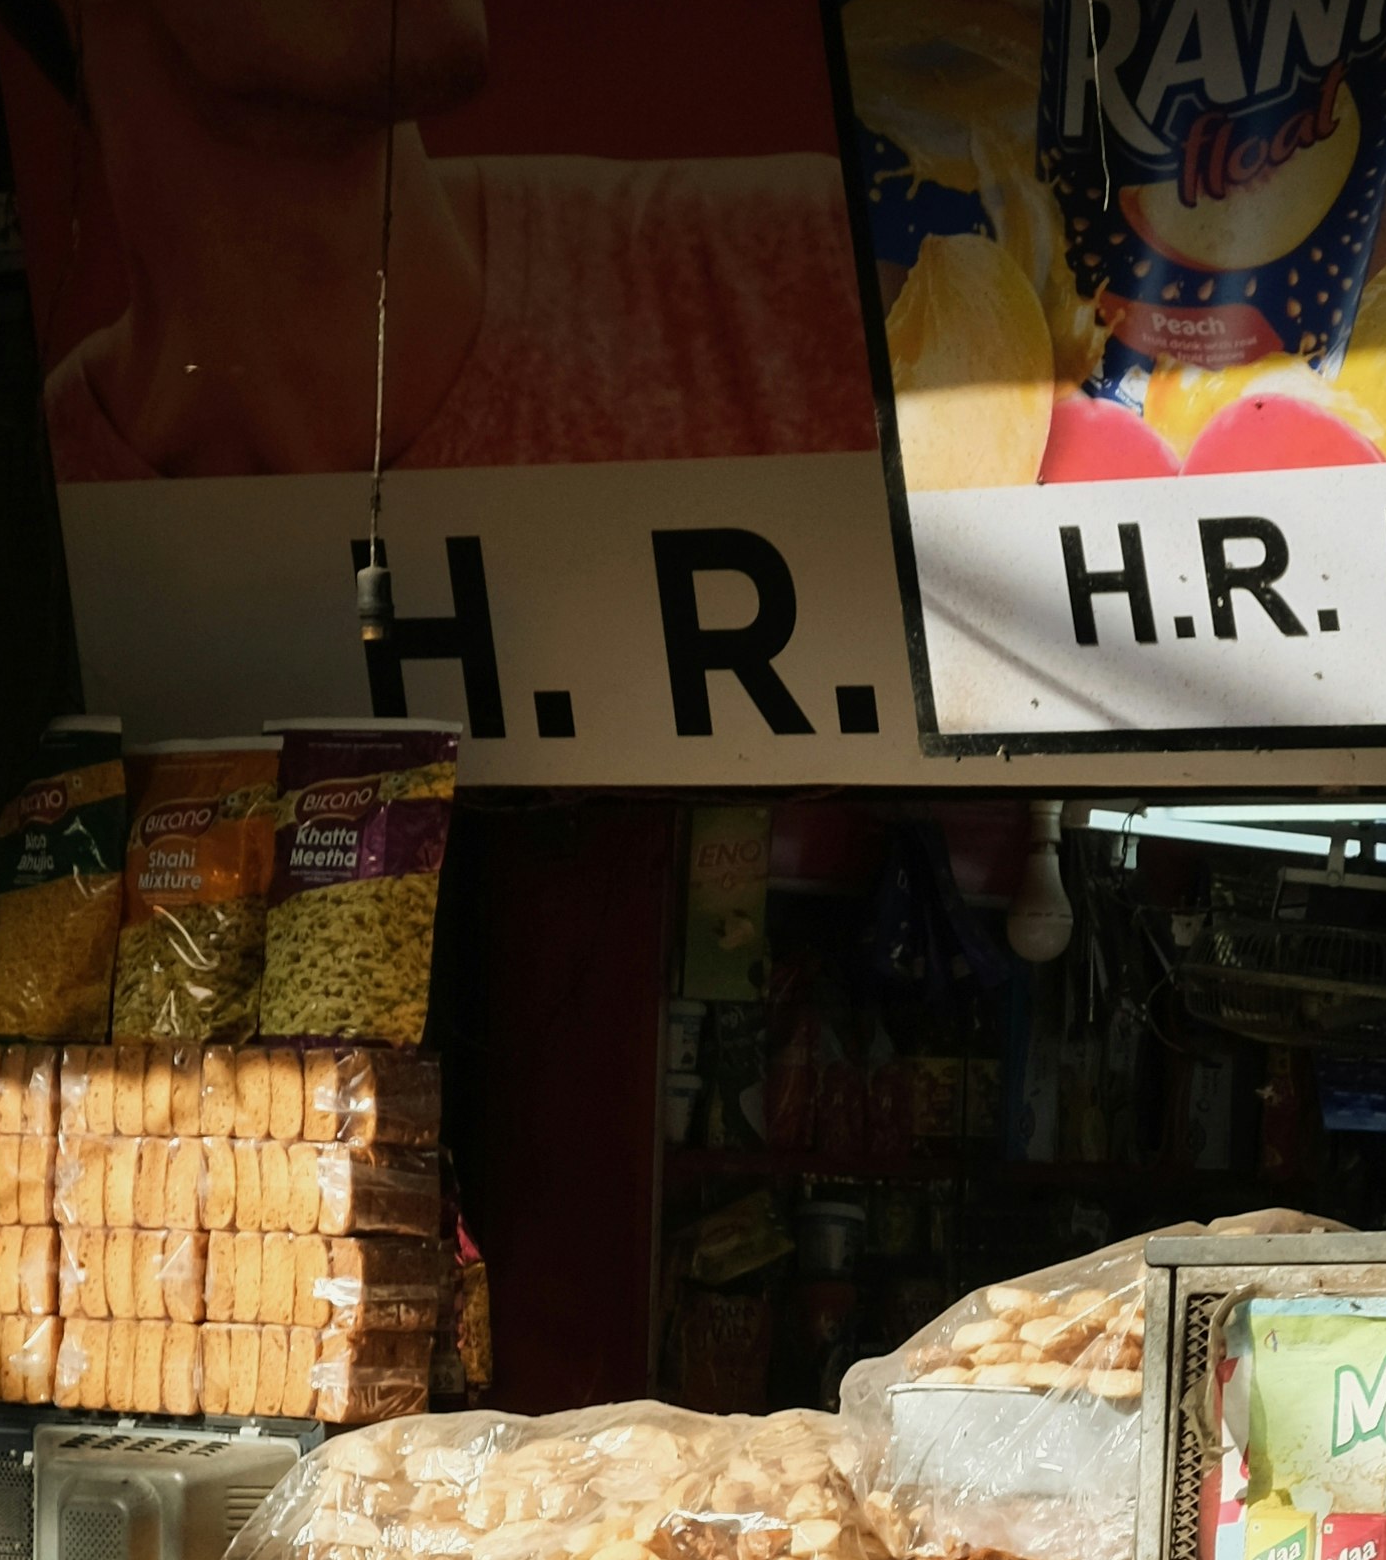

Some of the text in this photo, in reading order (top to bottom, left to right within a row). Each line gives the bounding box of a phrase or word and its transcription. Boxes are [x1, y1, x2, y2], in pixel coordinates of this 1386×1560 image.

[1175, 60, 1348, 208] float
[1151, 312, 1227, 337] Peach
[1058, 515, 1339, 645] H.R.
[351, 528, 880, 739] H. R.
[295, 826, 357, 847] Khatta
[148, 848, 196, 868] Shahi
[290, 848, 357, 869] Meetha
[697, 839, 762, 868] ENO
[138, 871, 203, 892] Mixture
